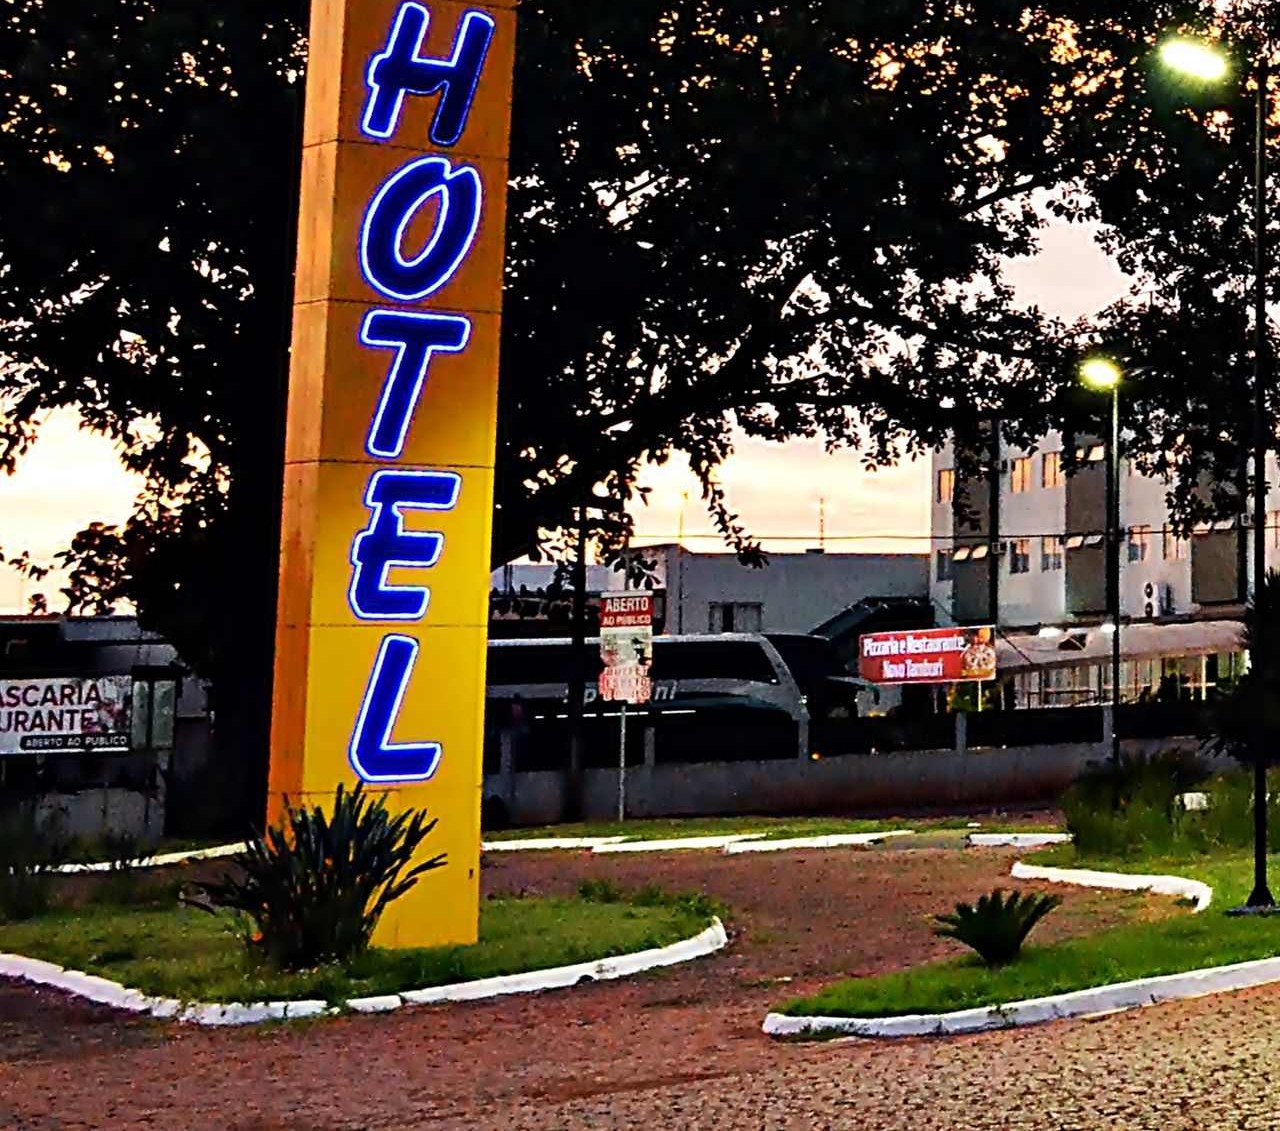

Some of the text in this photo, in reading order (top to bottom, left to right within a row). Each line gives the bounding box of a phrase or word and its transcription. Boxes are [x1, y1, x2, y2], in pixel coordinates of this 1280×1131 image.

[347, 0, 495, 784] HOTEL
[605, 597, 649, 612] ABERTO
[602, 617, 615, 626] AO
[906, 635, 965, 653] Restaurante
[0, 683, 100, 708] SCARIA
[25, 739, 63, 749] ABERTO
[68, 738, 81, 747] AO
